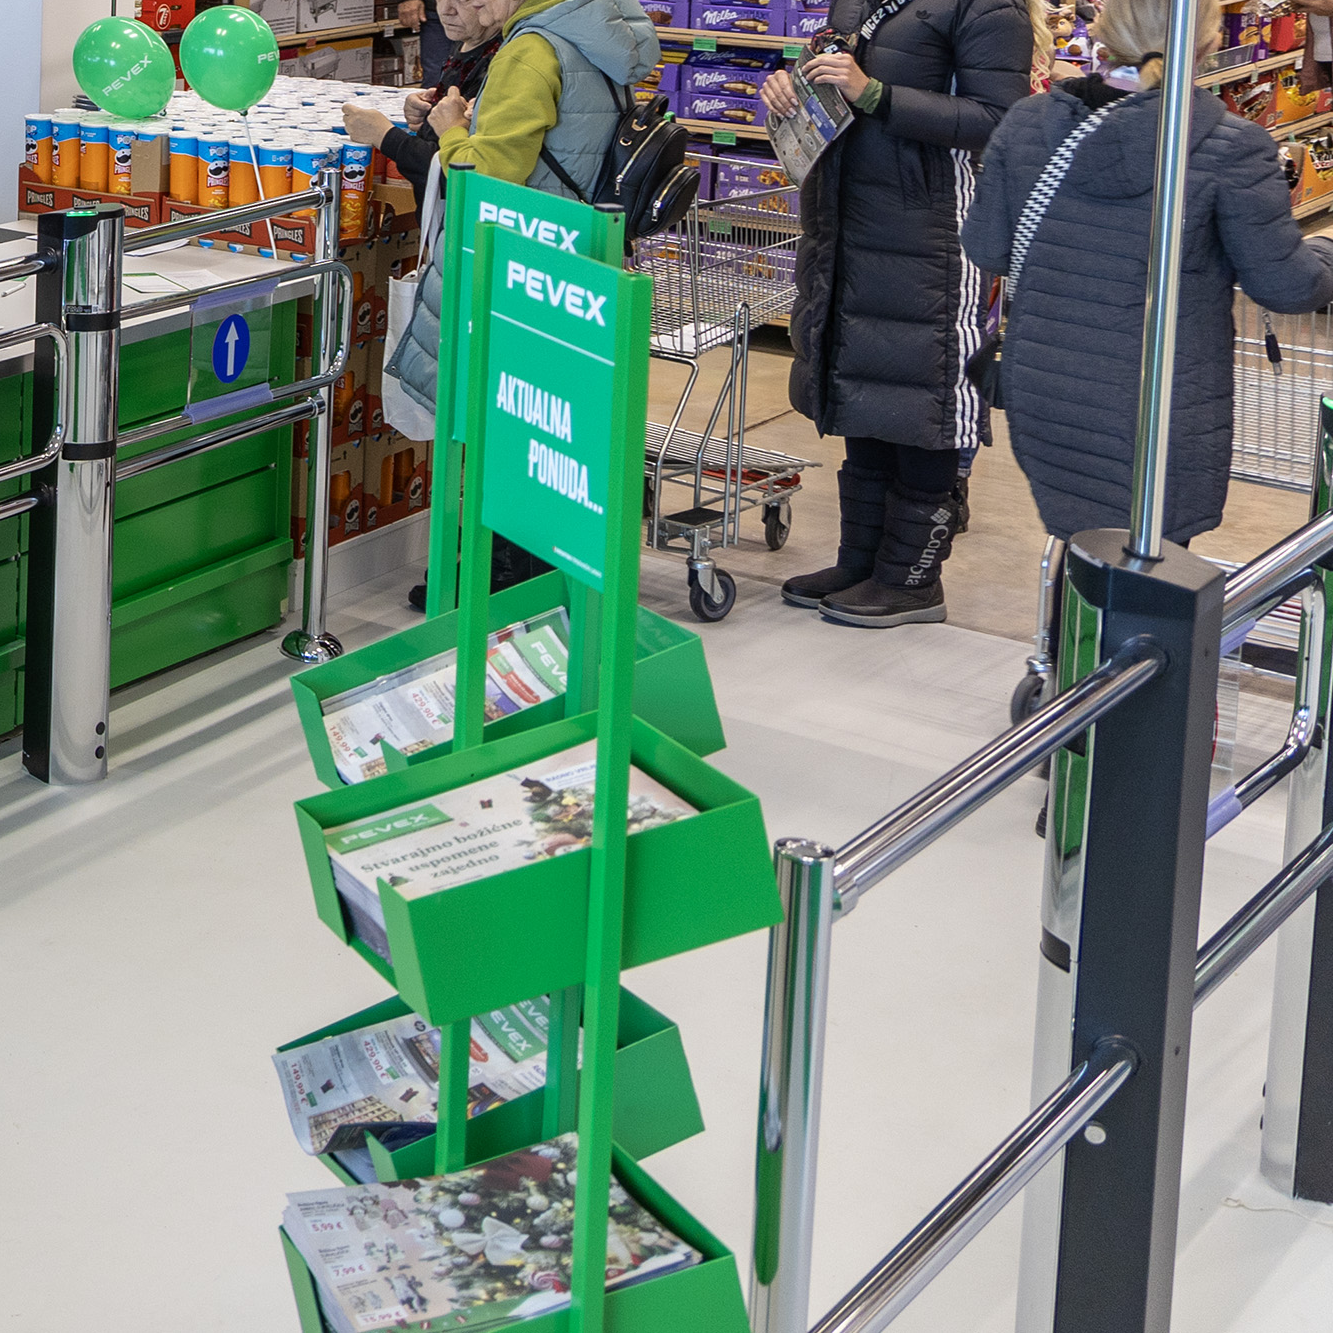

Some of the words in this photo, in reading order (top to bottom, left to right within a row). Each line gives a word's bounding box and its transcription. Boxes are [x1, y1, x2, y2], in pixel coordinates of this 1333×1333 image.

[703, 9, 738, 25] Milka
[101, 54, 152, 96] PEVEX
[693, 72, 727, 88] Milka
[691, 99, 727, 115] Milka
[346, 149, 368, 159] POP
[27, 190, 54, 208] PRINGLES
[273, 226, 304, 245] PRINGLES
[479, 201, 581, 254] PEVEX
[507, 259, 607, 327] PEVEX
[496, 371, 573, 444] AKTUALNA
[528, 438, 604, 515] PONUDA...
[340, 812, 429, 845] PEVEX
[360, 840, 453, 874] Stvarajmo
[454, 817, 524, 850] božićne
[408, 839, 500, 873] uspomene
[430, 853, 501, 880] zajedno
[362, 1040, 384, 1072] 429,90
[290, 1062, 306, 1096] 149,99
[311, 1222, 334, 1233] 5,99
[333, 1266, 356, 1277] 7,99
